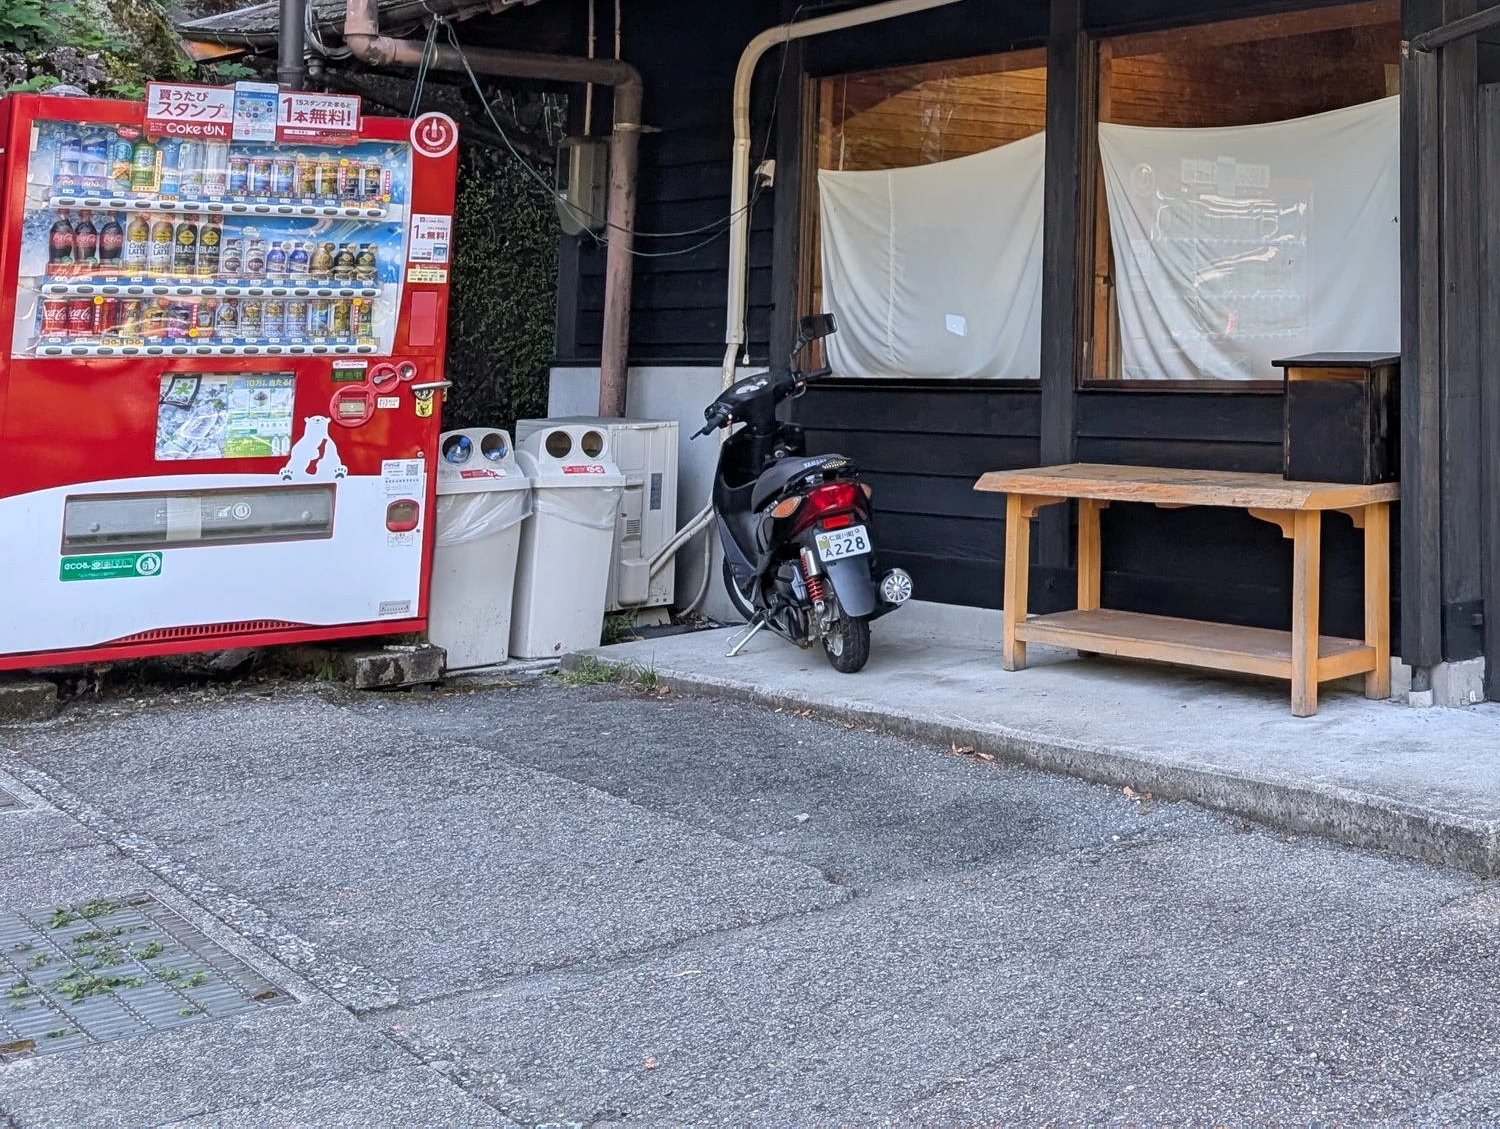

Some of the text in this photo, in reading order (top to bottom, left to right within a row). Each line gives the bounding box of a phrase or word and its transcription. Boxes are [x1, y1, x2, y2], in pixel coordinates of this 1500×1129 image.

[159, 89, 209, 102] 買うたび
[295, 99, 352, 108] 15スタンプたまると
[157, 102, 225, 119] スタンプ
[282, 97, 351, 126] 1本無料!
[166, 122, 201, 134] Coke
[413, 224, 448, 241] 1本無料!
[825, 536, 866, 558] A228
